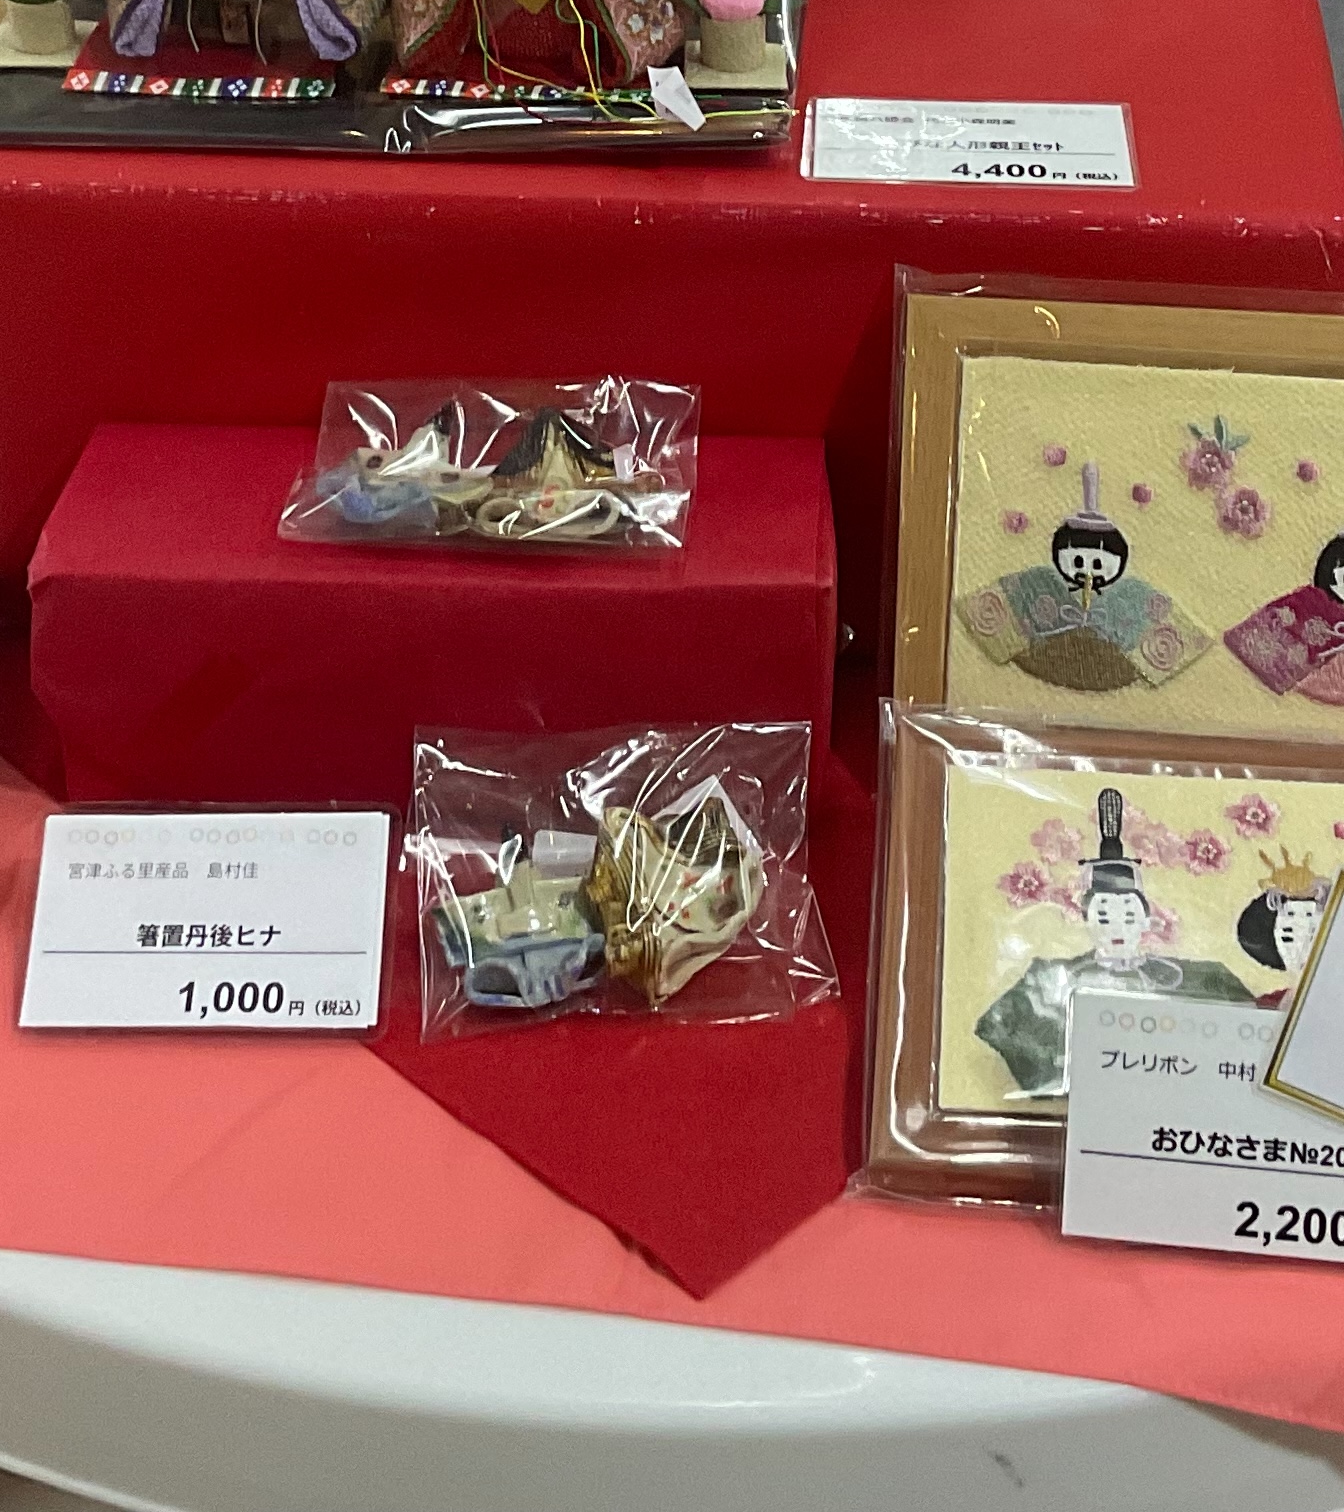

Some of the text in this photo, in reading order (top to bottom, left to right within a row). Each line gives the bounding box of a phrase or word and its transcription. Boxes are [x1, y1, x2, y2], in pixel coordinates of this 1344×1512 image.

[951, 162, 1047, 180] 4,400
[136, 923, 282, 948] 箸置丹後ヒナ
[178, 980, 284, 1020] 1,000
[1218, 1060, 1256, 1081] 中村
